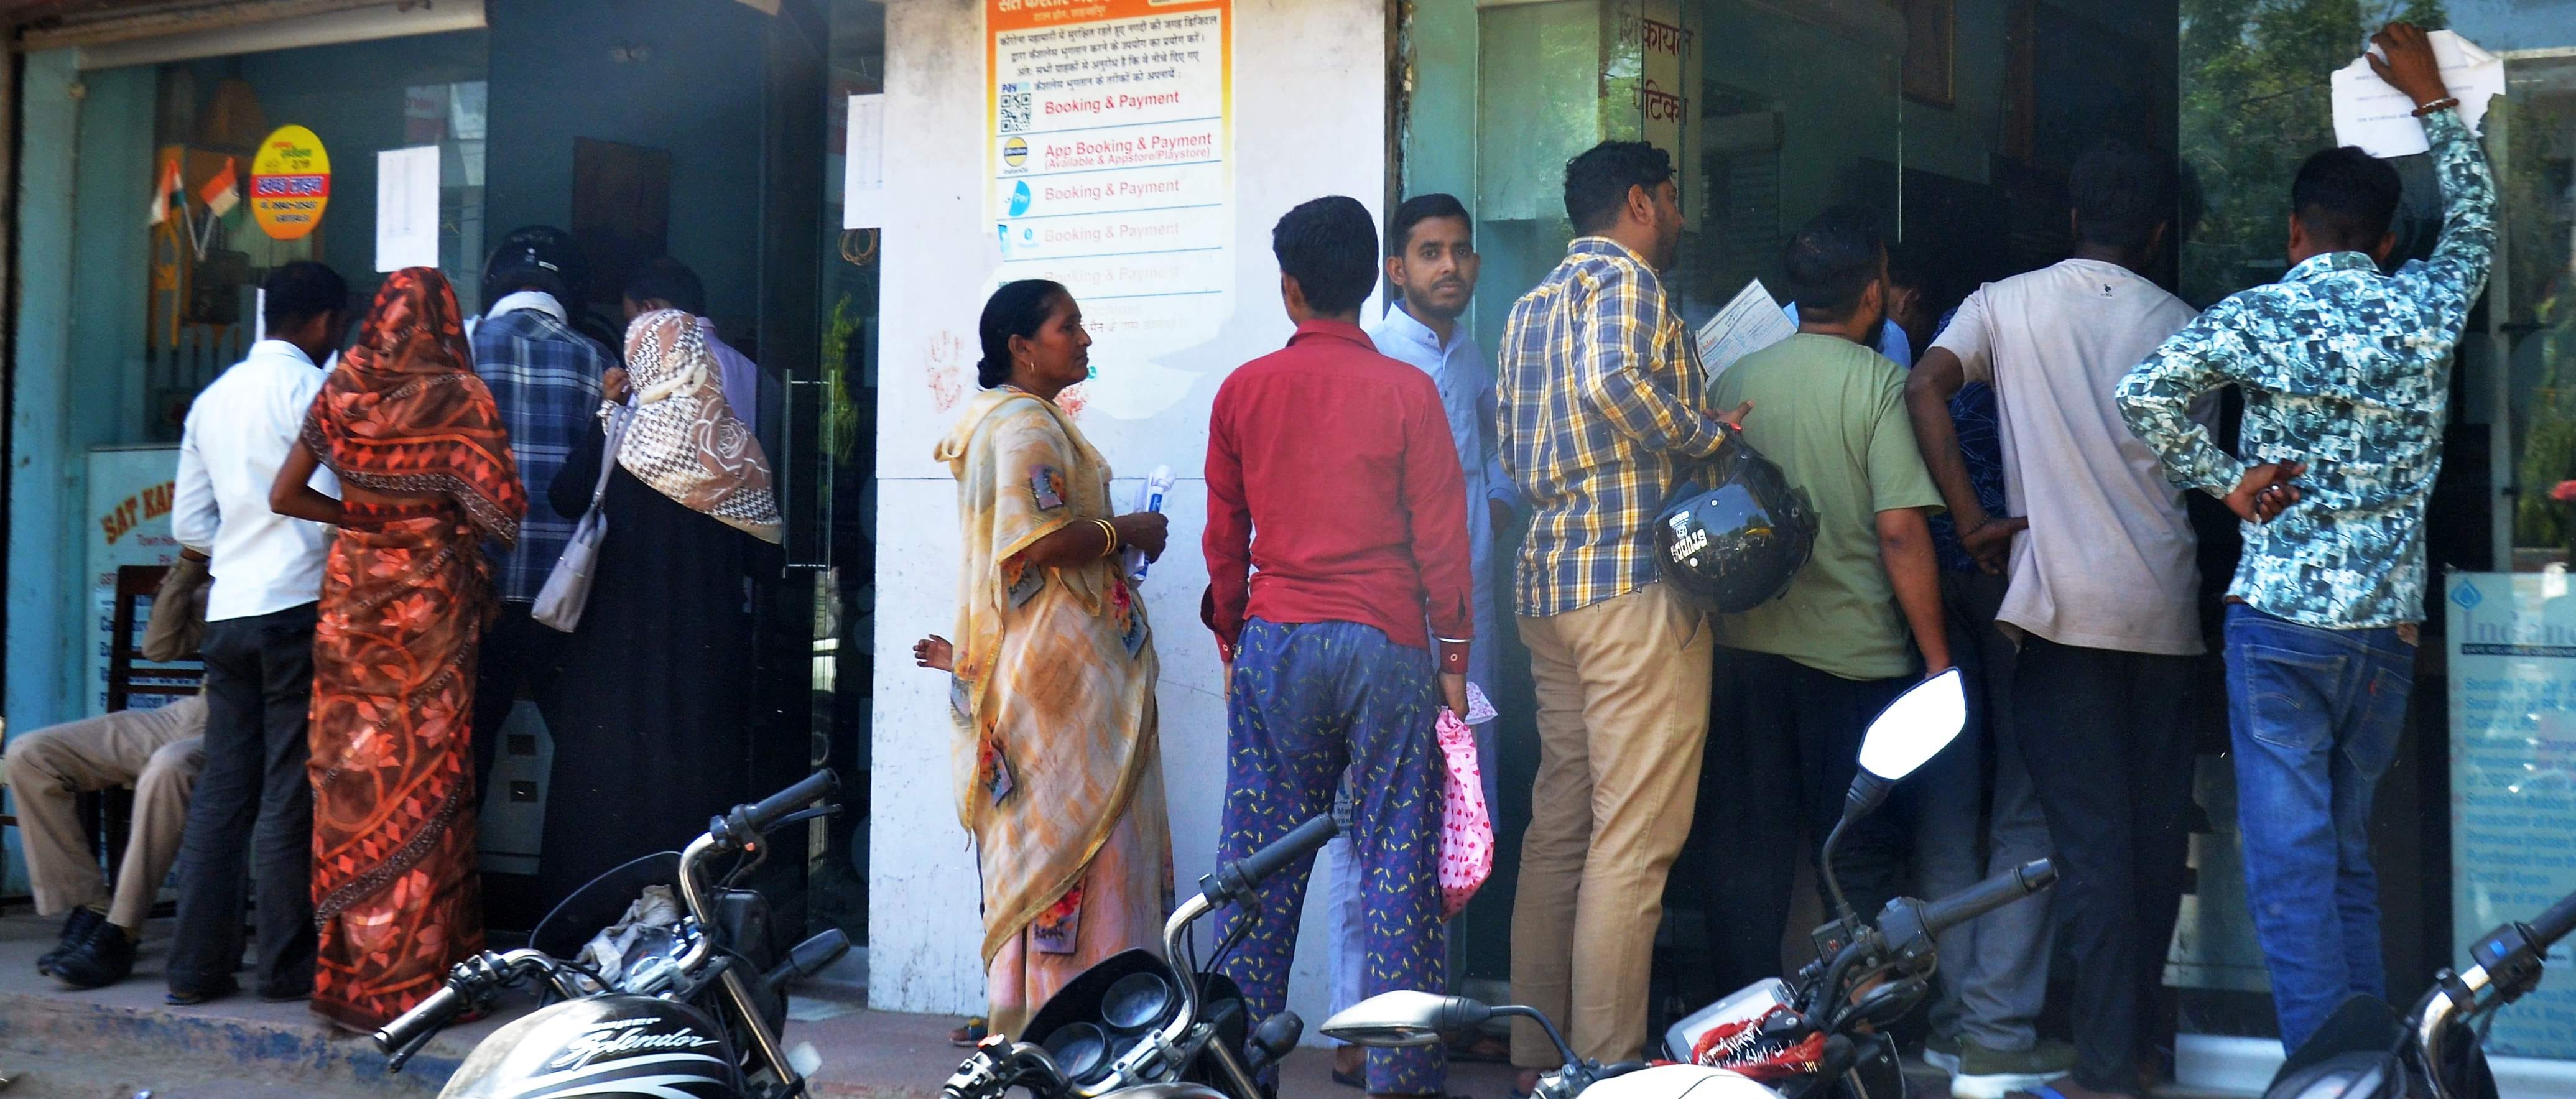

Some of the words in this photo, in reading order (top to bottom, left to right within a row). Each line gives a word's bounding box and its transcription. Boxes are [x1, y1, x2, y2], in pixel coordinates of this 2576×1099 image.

[999, 34, 1025, 45] कोरोना
[1028, 29, 1056, 43] महामारी
[1184, 14, 1217, 28] डिजिटल
[1061, 45, 1086, 58] भुगतान
[1067, 77, 1092, 90] भुगतान
[1045, 98, 1100, 114] Booking
[1105, 95, 1114, 109] &
[1119, 91, 1179, 110] Payment
[1045, 144, 1072, 159] App
[1077, 139, 1133, 155] Booking
[1137, 136, 1147, 150] &
[1152, 132, 1212, 151] Payment
[1045, 154, 1093, 170] (Available
[1045, 184, 1101, 201] Booking
[1105, 182, 1114, 196] &
[1120, 179, 1180, 198] Payment
[1045, 228, 1101, 243] Booking
[1105, 226, 1114, 238] &
[1120, 221, 1180, 241] Payment
[100, 494, 139, 547] SAT
[551, 1027, 720, 1070] Splendor
